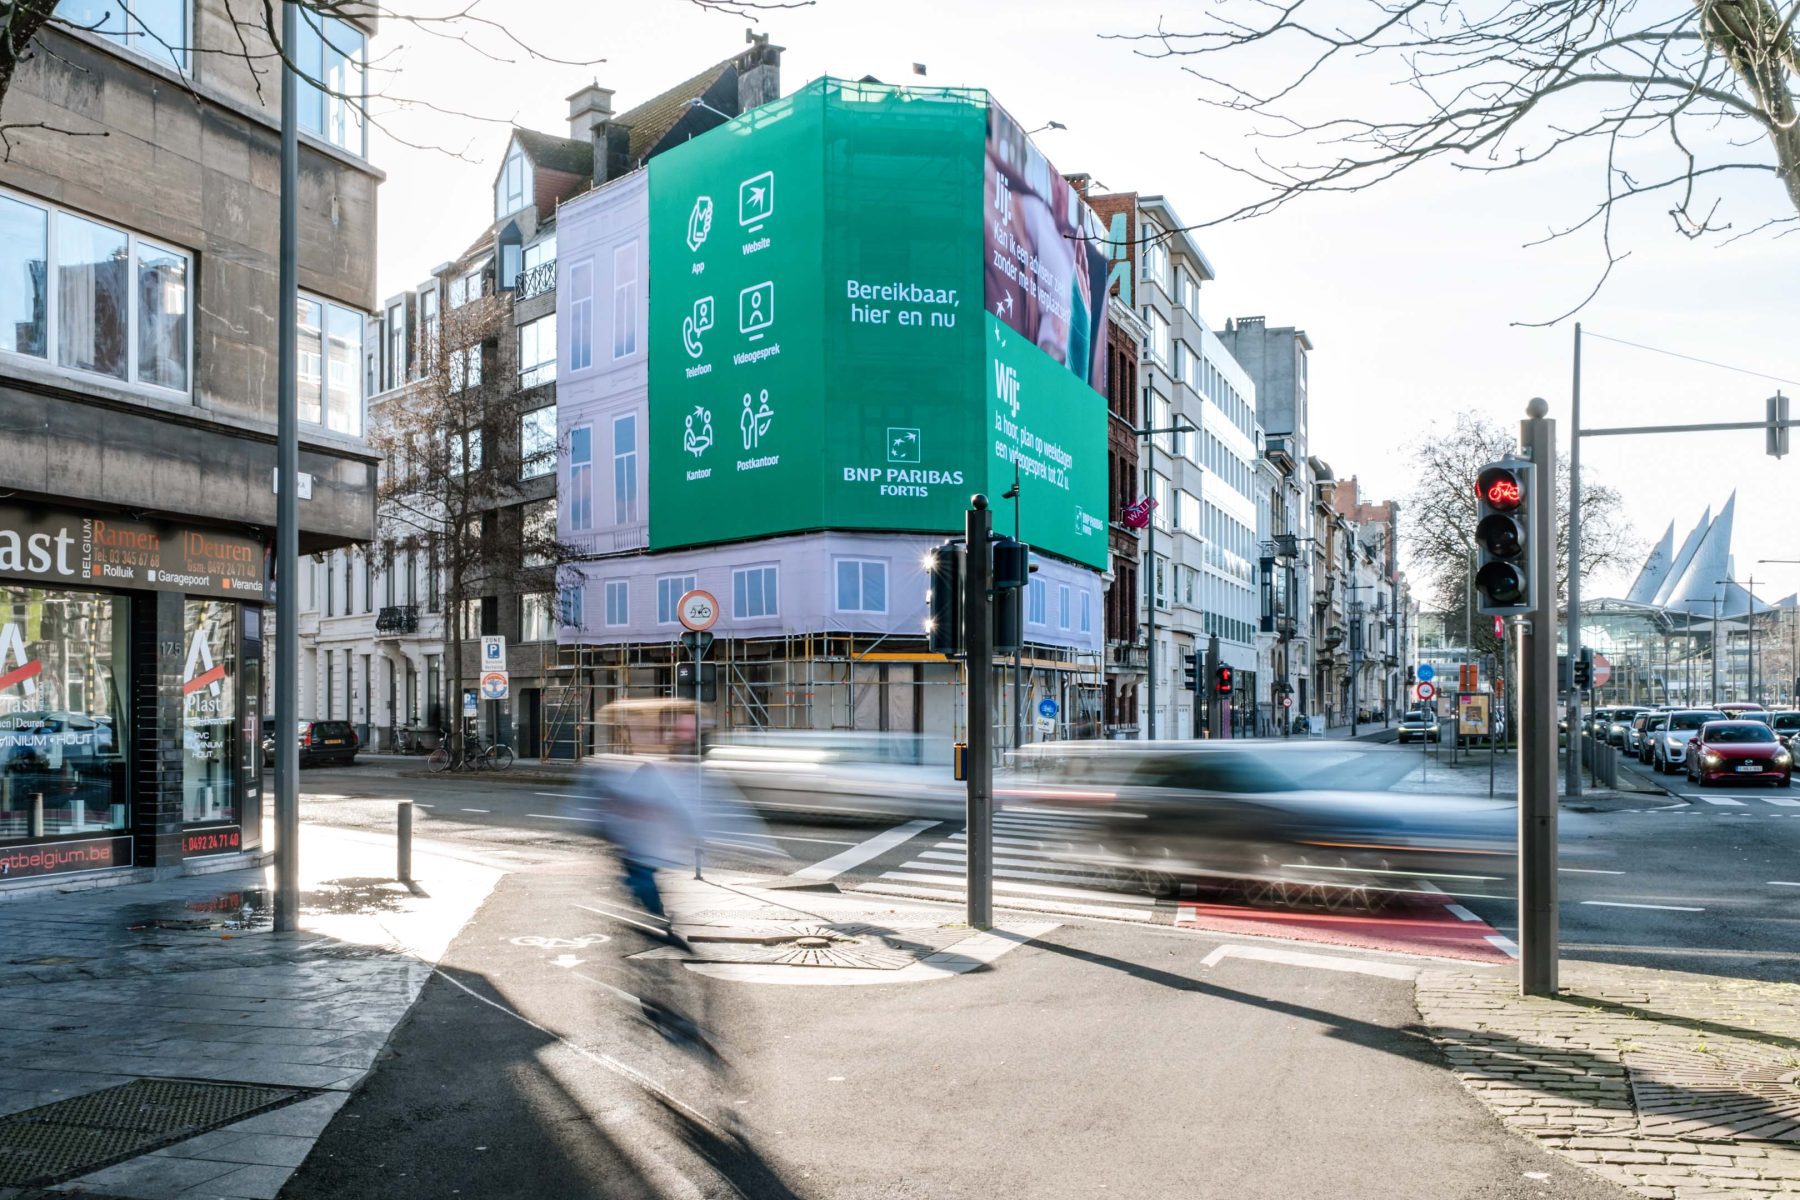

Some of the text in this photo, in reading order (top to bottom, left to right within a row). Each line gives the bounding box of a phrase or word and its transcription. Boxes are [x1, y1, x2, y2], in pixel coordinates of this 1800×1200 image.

[994, 171, 1012, 226] Jij:
[742, 237, 770, 256] Website
[994, 220, 1008, 249] Kan
[1010, 233, 1016, 256] ik
[1017, 245, 1028, 267] een
[692, 262, 704, 275] App
[994, 250, 1017, 281] zonder
[1019, 271, 1028, 292] me
[1030, 277, 1036, 298] te
[847, 280, 960, 307] Bereikbaar,
[851, 303, 955, 328] hier en nu
[733, 344, 780, 366] Videogesprek
[685, 364, 712, 379] Telefoon
[995, 358, 1020, 418] Wij:
[995, 410, 1072, 471] Ja hoor, plan op weekdagen
[736, 455, 780, 472] Postkantoor
[996, 440, 1007, 460] een
[1009, 445, 1047, 480] videogesprek
[1048, 463, 1056, 484] tot
[1057, 468, 1063, 488] 22
[686, 468, 711, 481] Kantoor
[844, 468, 964, 484] BNP PARIBAS
[880, 485, 928, 497] FORTIS
[94, 520, 159, 550] Ramen
[82, 518, 91, 578] BELGIUM
[191, 532, 252, 562] Deuren
[109, 549, 119, 564] 03
[122, 550, 136, 566] 345
[139, 552, 148, 568] 67
[150, 554, 160, 568] 68
[103, 564, 134, 579] Rolluik
[208, 561, 224, 575] 0492
[227, 563, 236, 576] 24
[237, 564, 245, 576] 71
[158, 570, 210, 586] Garagepoort
[232, 579, 263, 591] Veranda
[162, 642, 180, 657] 175
[187, 694, 221, 711] Plast
[16, 718, 45, 728] Deuren
[56, 734, 93, 745] HOUT
[188, 836, 207, 850] 0492
[208, 835, 217, 848] 24
[220, 834, 228, 848] 71
[230, 833, 239, 846] 40
